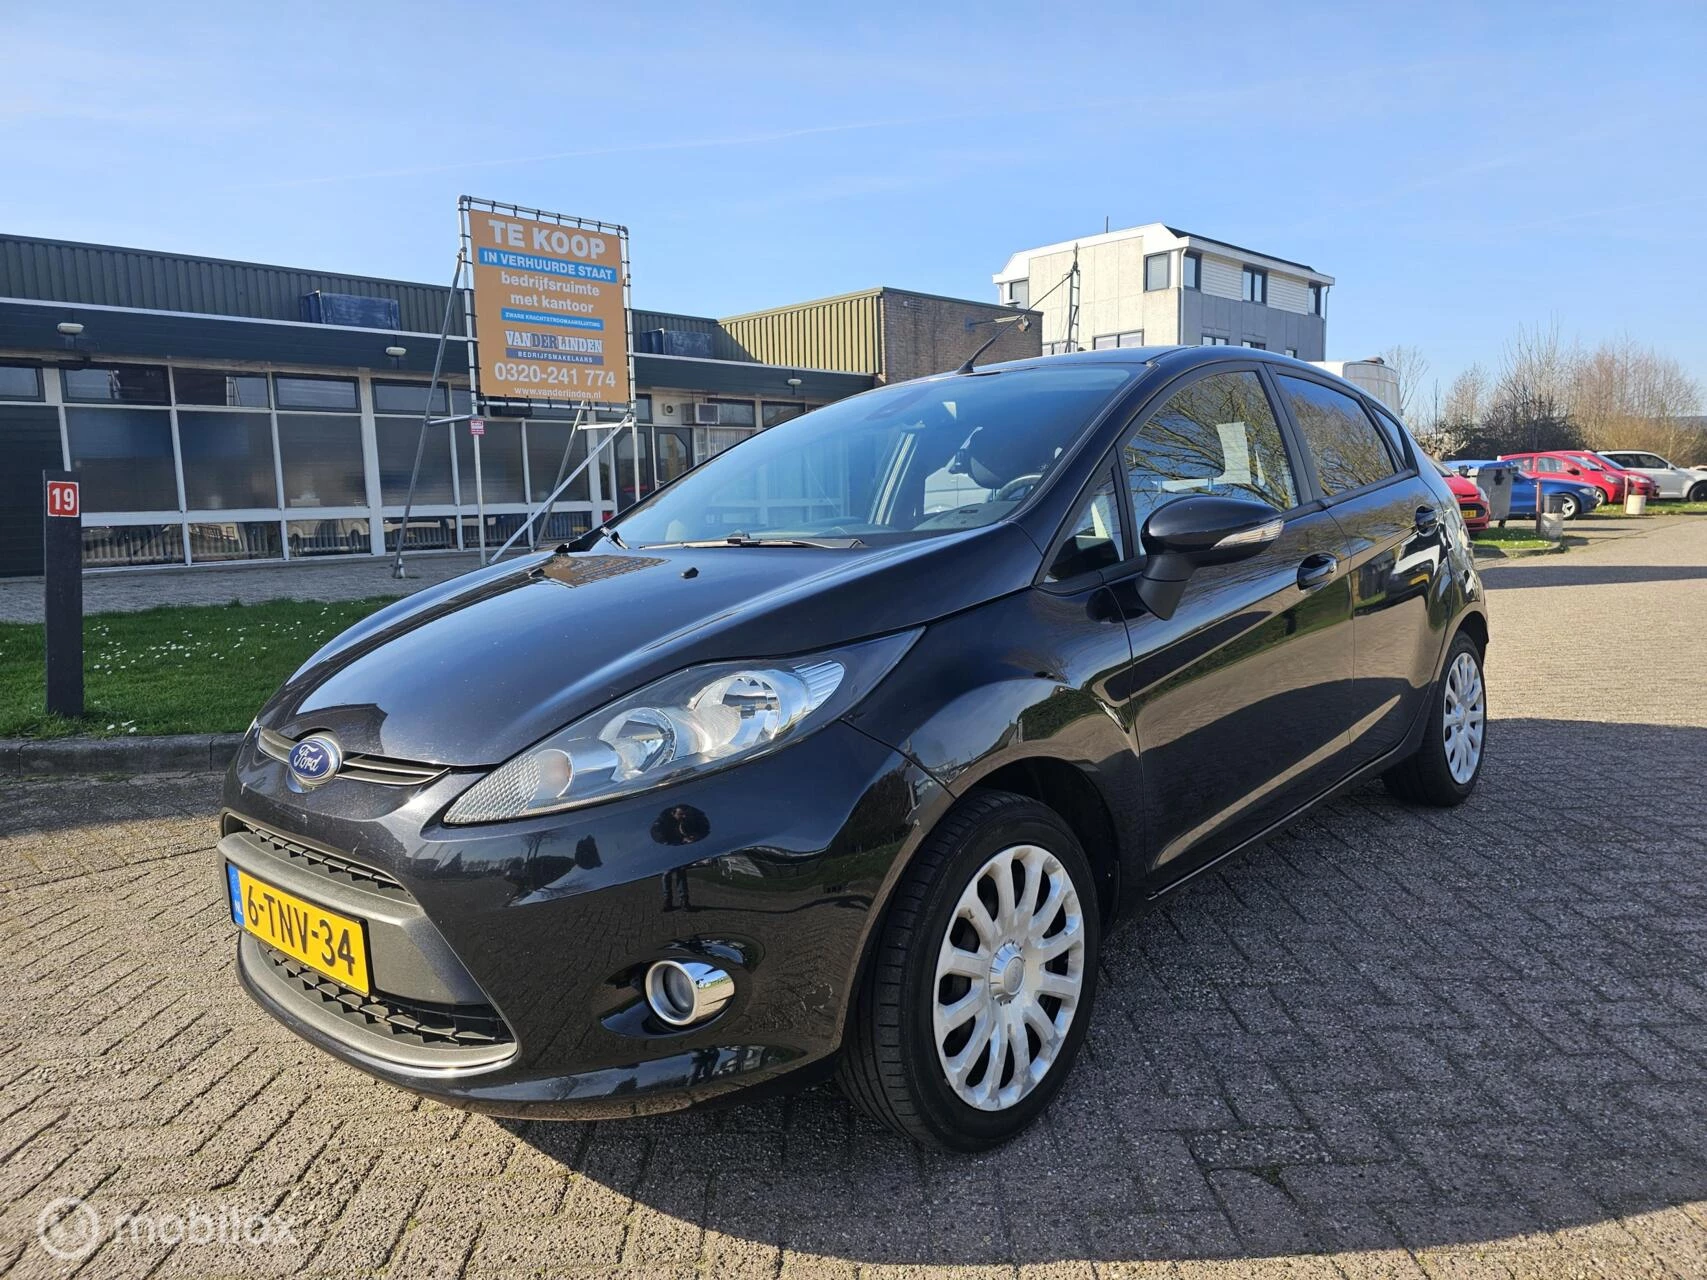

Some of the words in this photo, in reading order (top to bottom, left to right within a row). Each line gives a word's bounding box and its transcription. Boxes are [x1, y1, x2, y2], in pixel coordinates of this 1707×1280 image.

[488, 219, 525, 248] TE
[533, 227, 606, 260] KOOP
[484, 251, 497, 263] IN
[500, 253, 575, 275] VERHUURDE
[578, 266, 612, 281] STAAT
[501, 271, 600, 296] bedrijfsruimte
[511, 293, 538, 306] met
[542, 295, 594, 313] kantoor
[518, 351, 593, 363] BEDRIJFSMAKELAARS
[494, 362, 578, 384] 0320-241
[585, 369, 616, 387] 774
[514, 386, 601, 399] www.vanderlinden.nl
[52, 488, 75, 510] 19
[293, 744, 322, 773] Ford
[247, 885, 355, 976] 6-TNV-34
